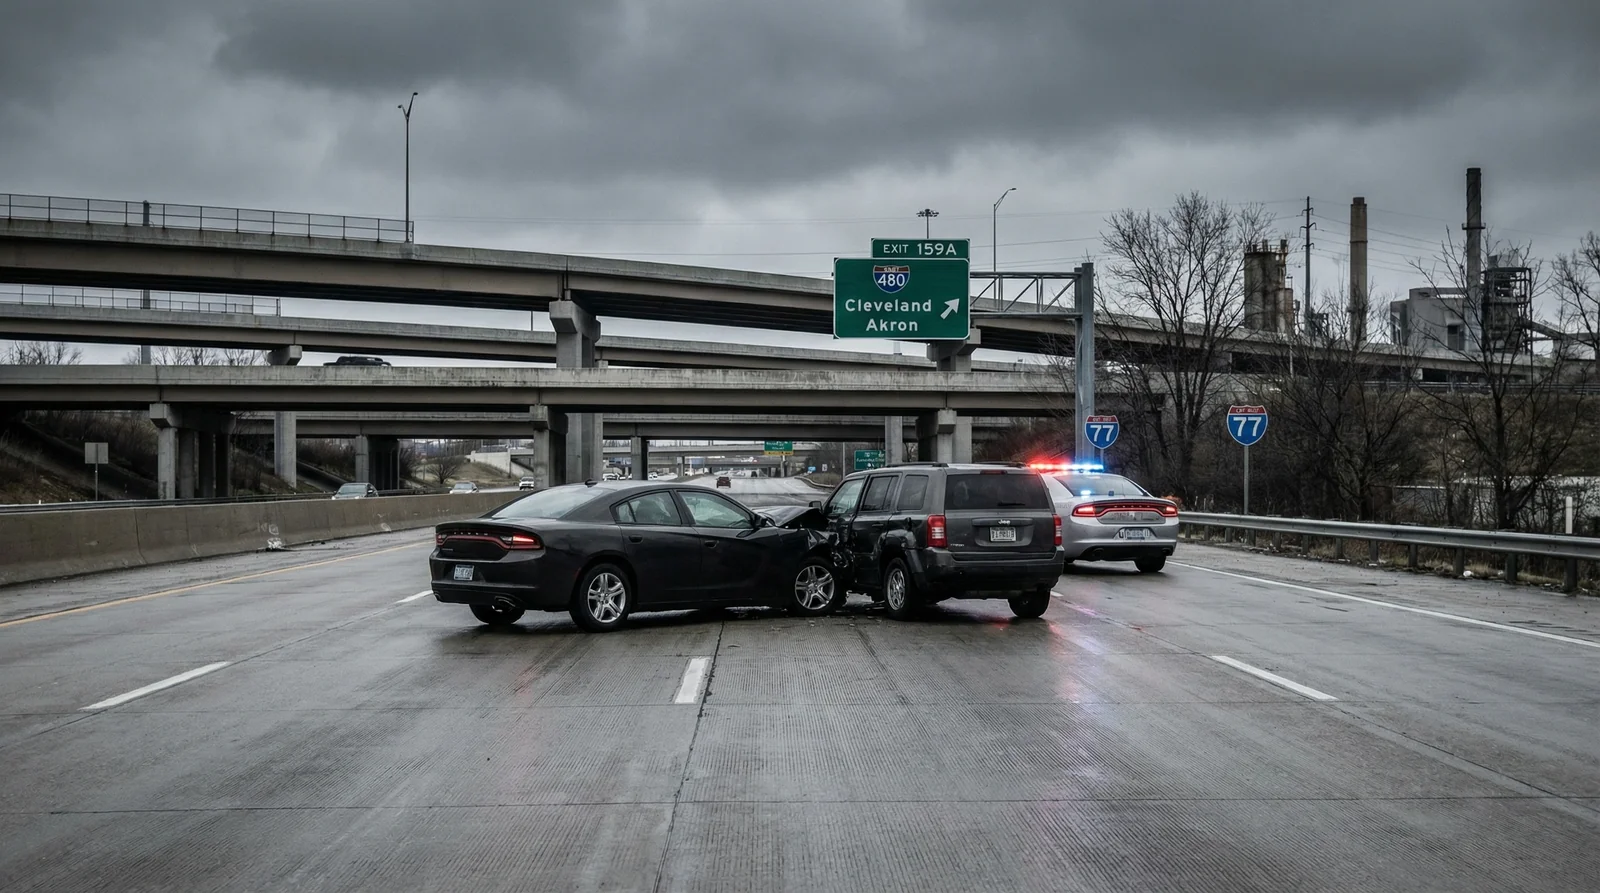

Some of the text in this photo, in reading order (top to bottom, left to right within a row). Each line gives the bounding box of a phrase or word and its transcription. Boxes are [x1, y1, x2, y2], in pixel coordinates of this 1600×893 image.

[883, 243, 957, 256] EXIT 159A
[877, 273, 906, 287] 480
[845, 299, 932, 312] Cleveland
[866, 318, 918, 331] Akron
[1090, 424, 1115, 442] 77
[1232, 416, 1262, 437] 77
